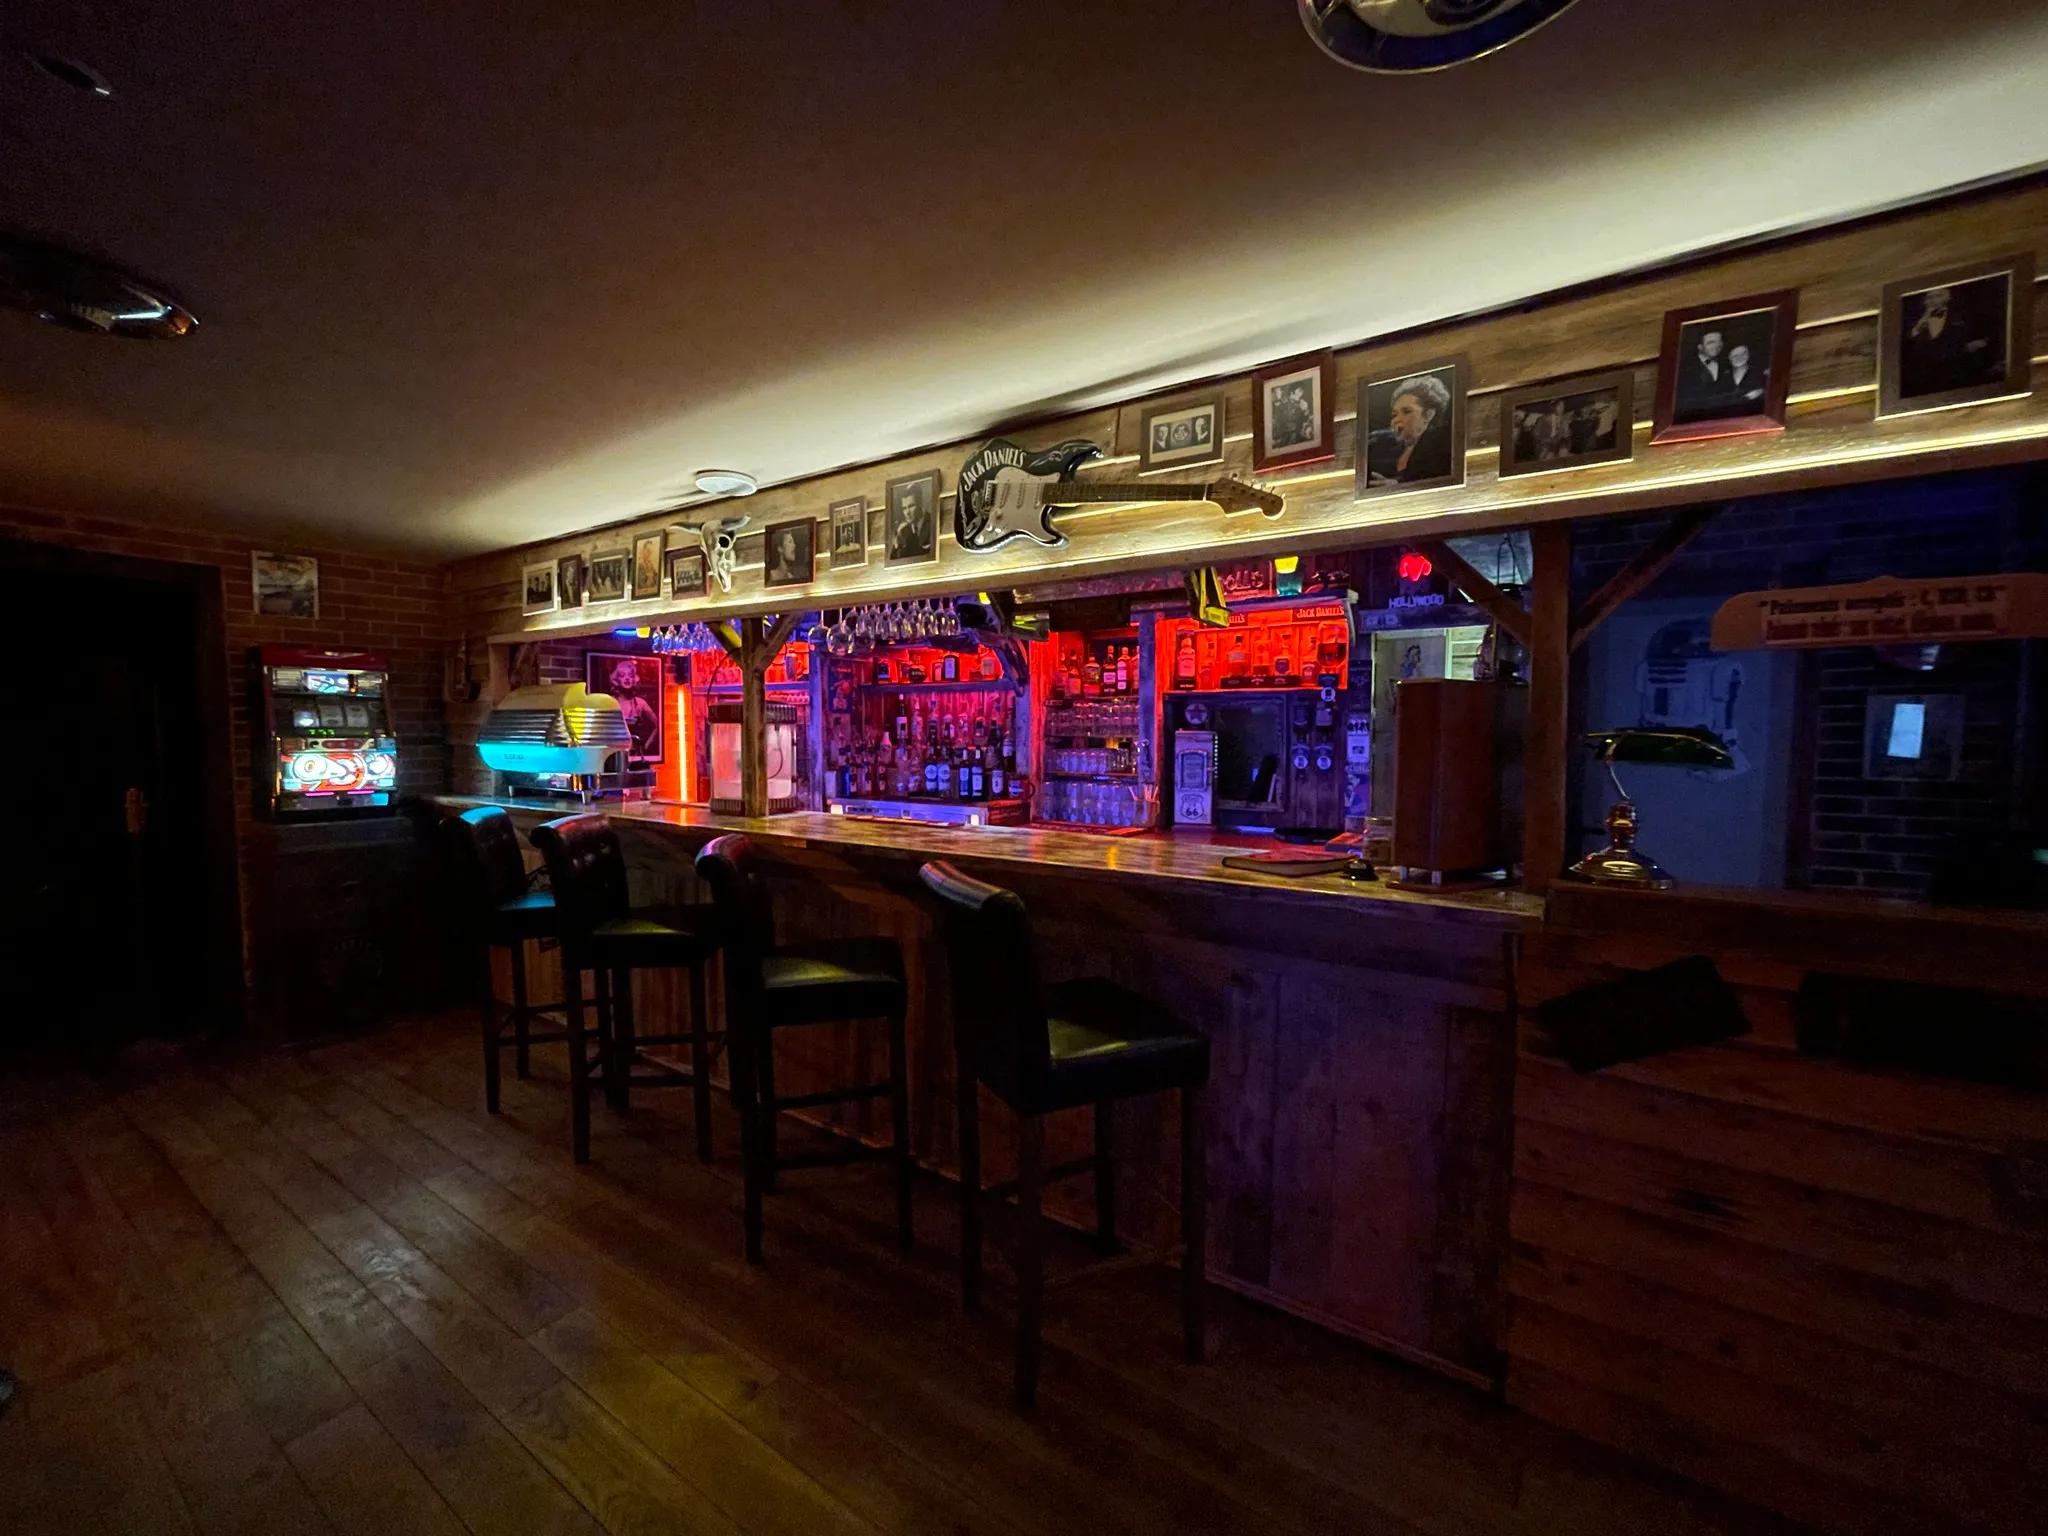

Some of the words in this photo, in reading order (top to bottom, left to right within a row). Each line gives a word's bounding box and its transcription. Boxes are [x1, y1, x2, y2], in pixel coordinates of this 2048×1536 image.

[962, 460, 985, 492] JACK
[984, 447, 1027, 470] DANIEL'S
[1388, 594, 1445, 608] HOLLYWOOD
[1296, 608, 1315, 619] JACK
[1186, 807, 1199, 817] 66
